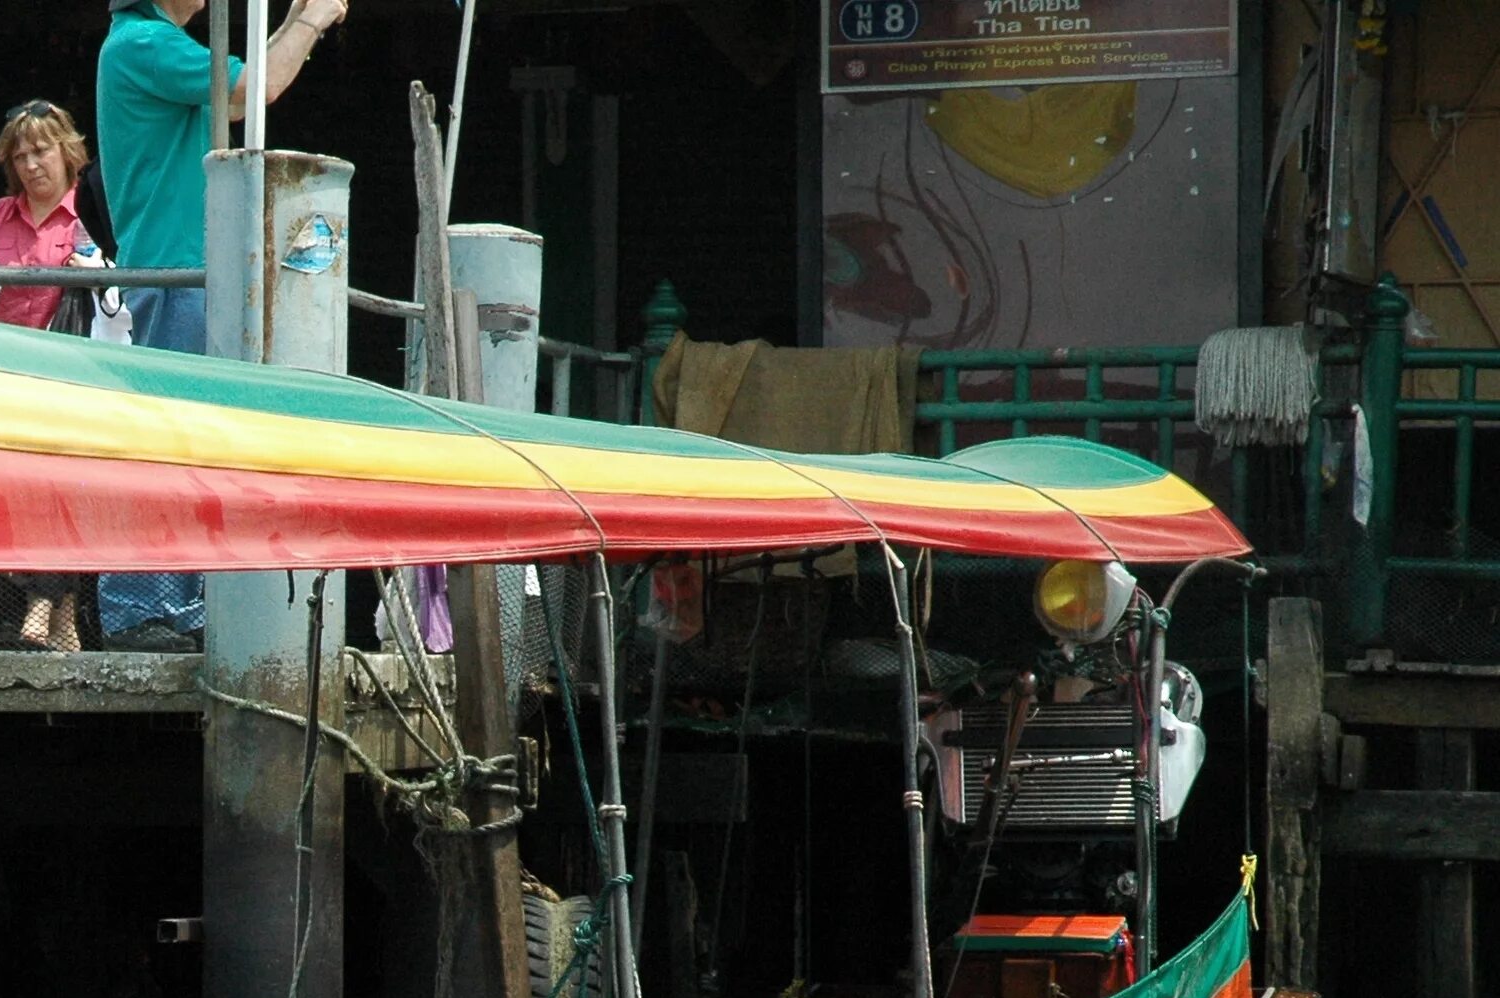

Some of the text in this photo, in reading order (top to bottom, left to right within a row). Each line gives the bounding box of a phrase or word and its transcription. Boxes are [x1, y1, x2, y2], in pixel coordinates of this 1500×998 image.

[856, 19, 873, 36] N
[884, 4, 904, 33] 8
[973, 16, 1091, 35] Tha Tien
[887, 63, 927, 73] Chao
[993, 57, 1054, 69] Express
[1060, 54, 1097, 65] Boat
[1103, 52, 1169, 63] Services
